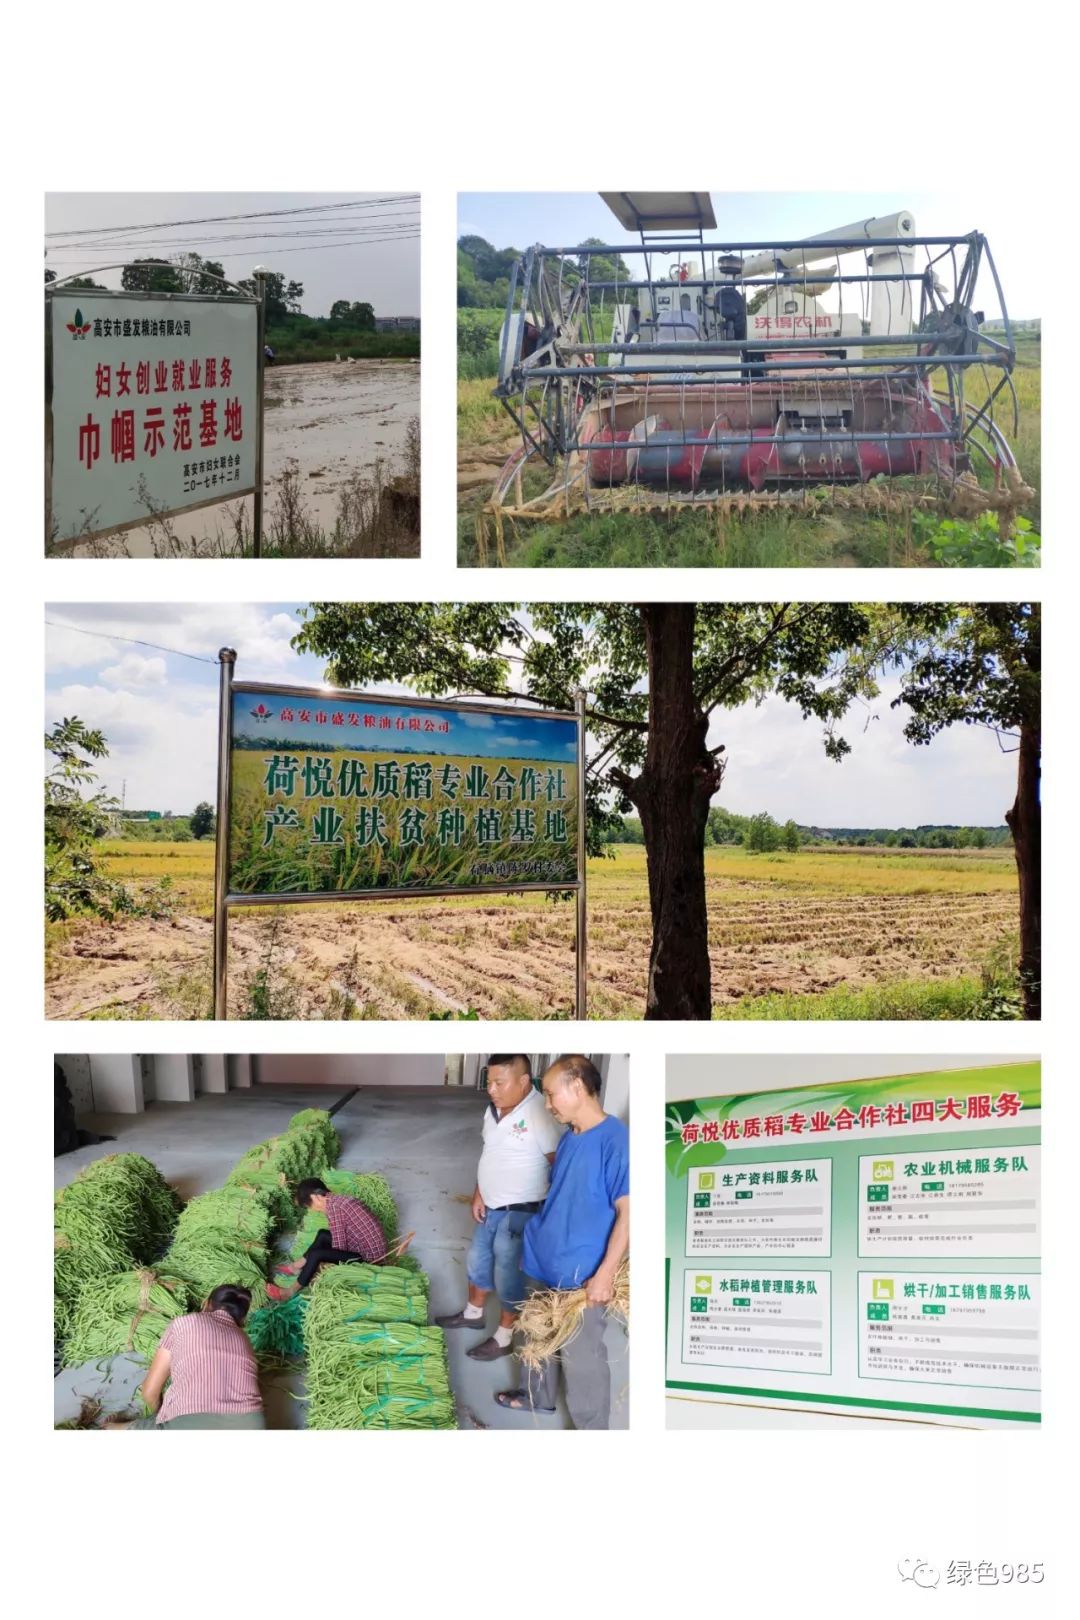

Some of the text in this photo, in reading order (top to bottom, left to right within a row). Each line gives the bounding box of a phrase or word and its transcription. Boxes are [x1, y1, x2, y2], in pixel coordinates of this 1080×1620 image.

[93, 319, 192, 337] 高安市盛发粮油有限公司
[95, 356, 233, 399] 妇女创业就业服务
[78, 396, 244, 470] 巾帼示范基地
[182, 454, 241, 477] 高安市妇女联合会
[279, 706, 451, 734] 高安市盛发粮油有限公司
[263, 755, 568, 803] 荷悦优质稻专业合作社
[263, 806, 569, 848] 产业扶贫种植基地
[680, 1091, 1023, 1145] 荷悦优质稻专业合作社四大服务
[721, 1168, 819, 1187] 生产资料服务队
[903, 1156, 1028, 1177] 农业机械服务队
[719, 1279, 818, 1295] 水稻种植管理服务队
[903, 1282, 1031, 1300] 烘干/加工销售服务队
